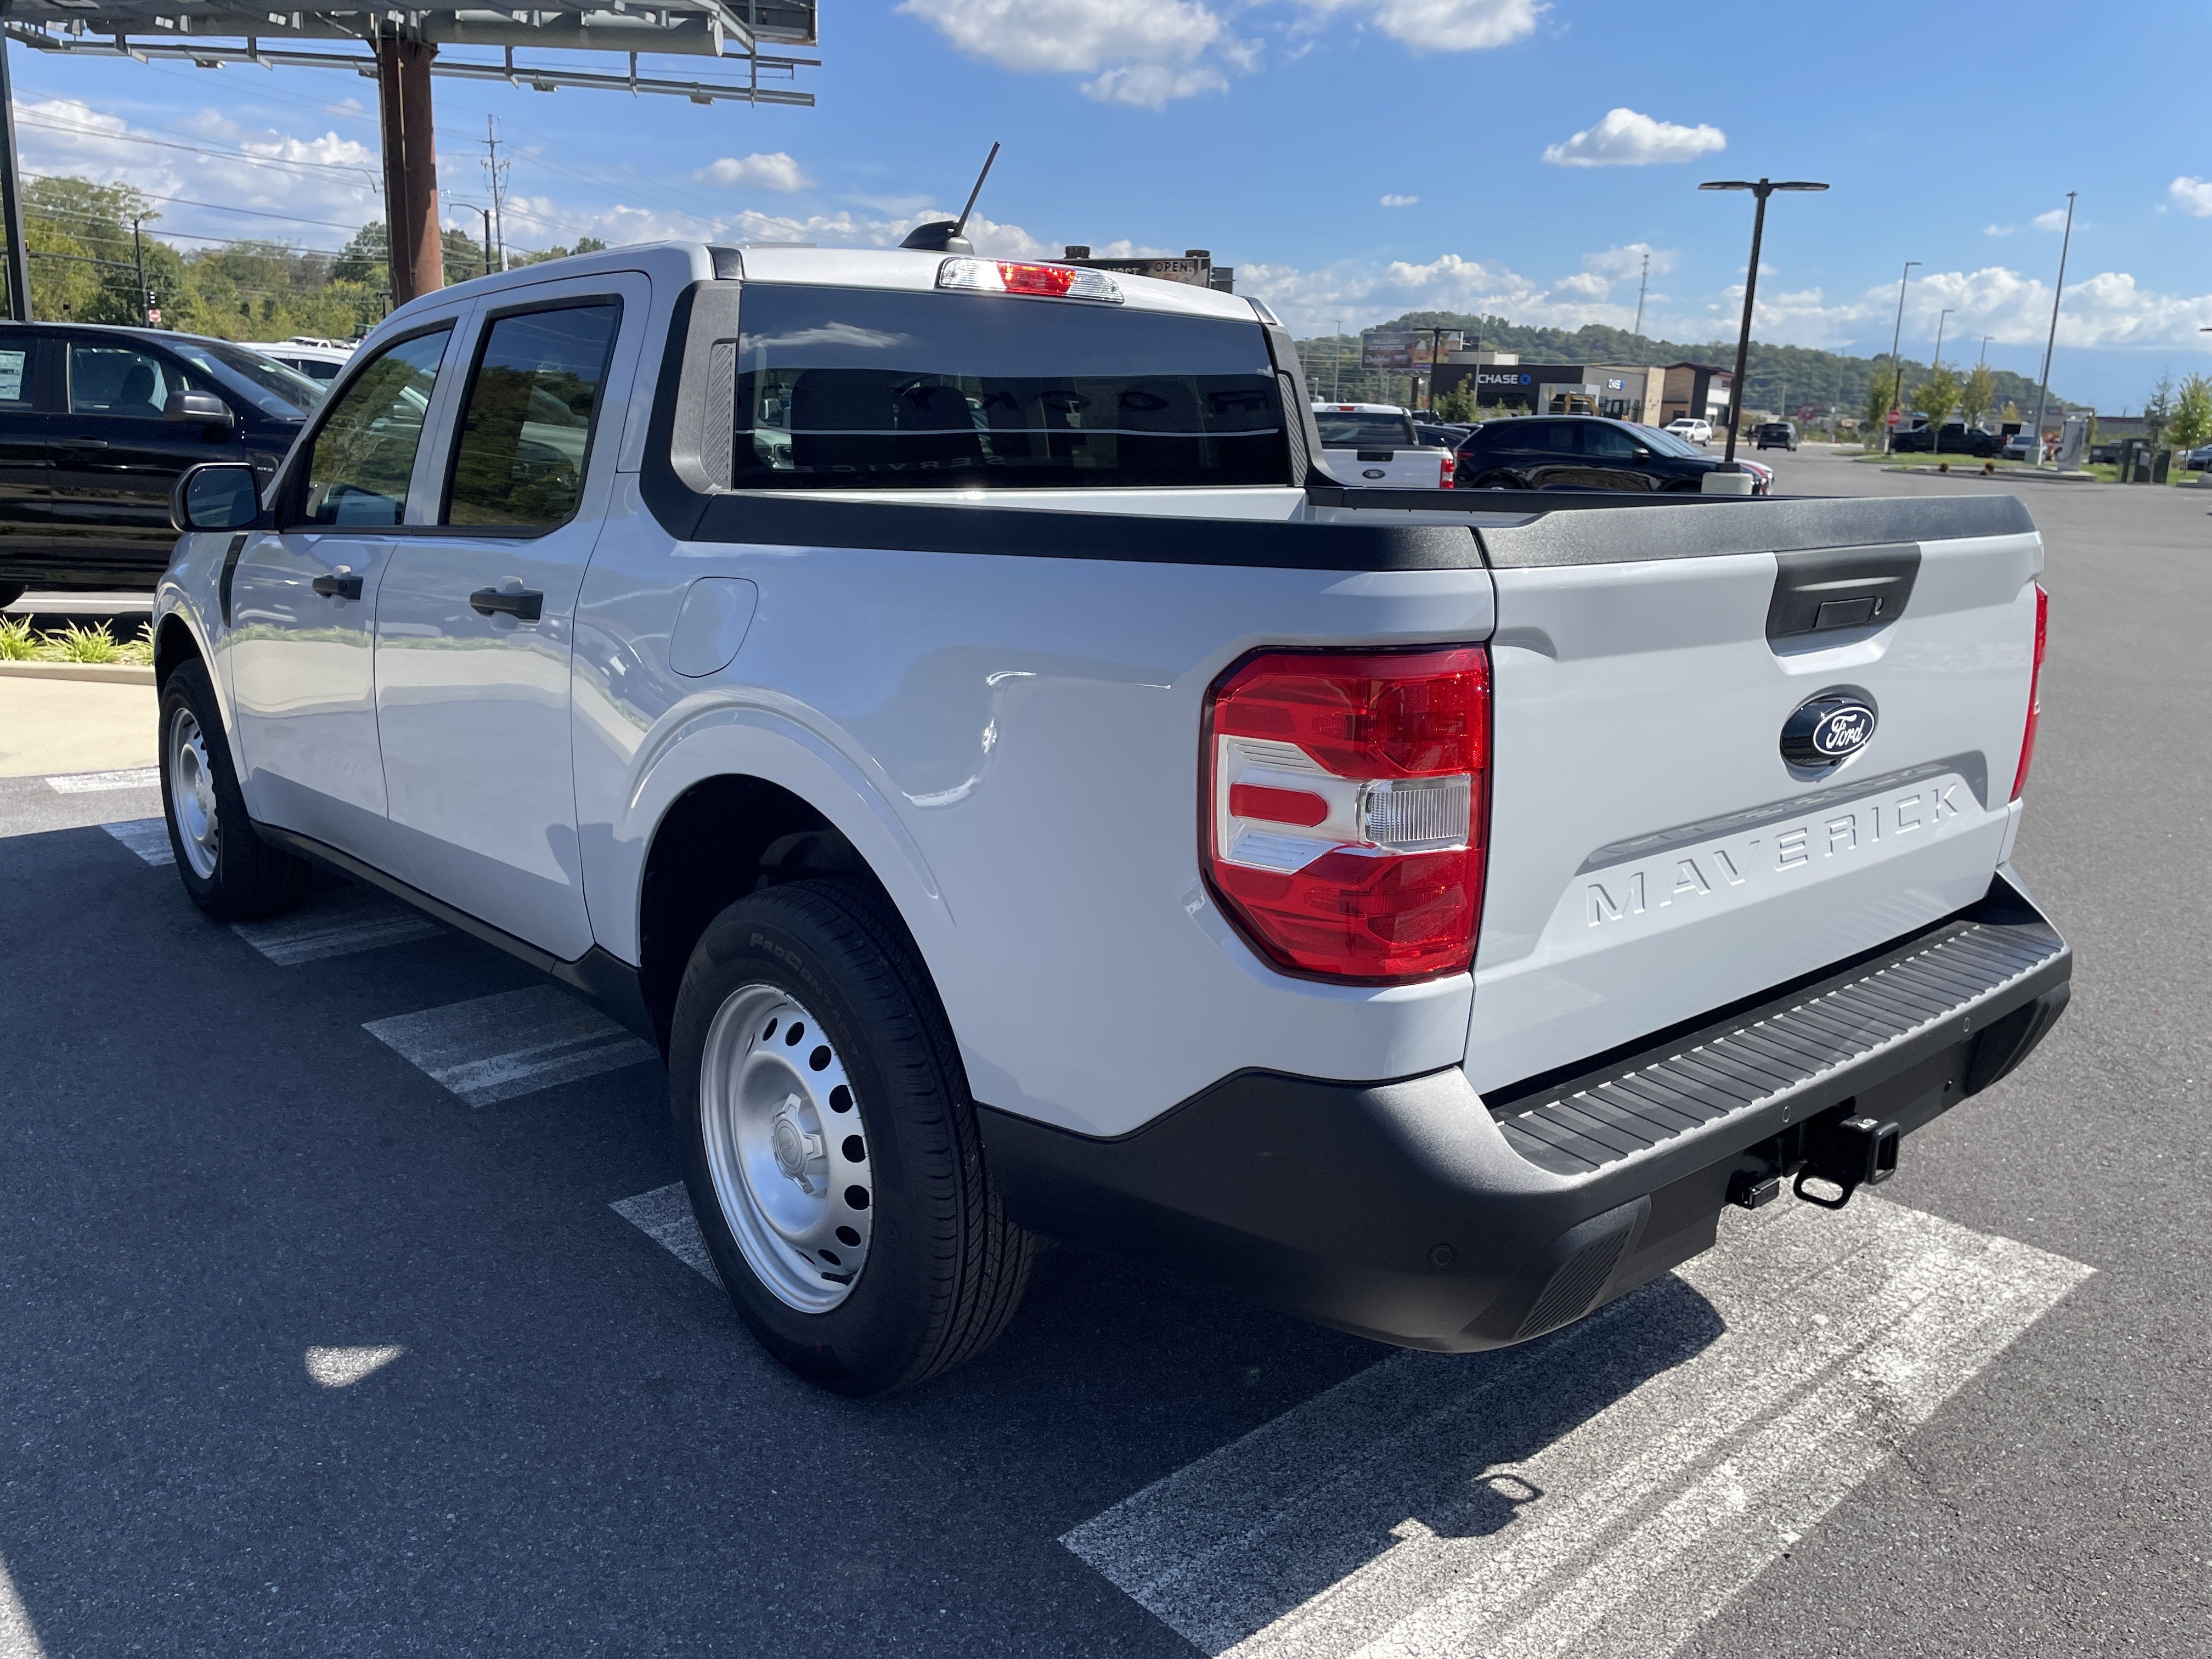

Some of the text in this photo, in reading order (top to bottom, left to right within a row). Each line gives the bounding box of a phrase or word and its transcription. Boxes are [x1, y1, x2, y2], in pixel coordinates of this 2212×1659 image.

[1478, 374, 1519, 384] CHASE
[1825, 713, 1865, 749] Ford
[1587, 782, 1959, 928] MAVERICK
